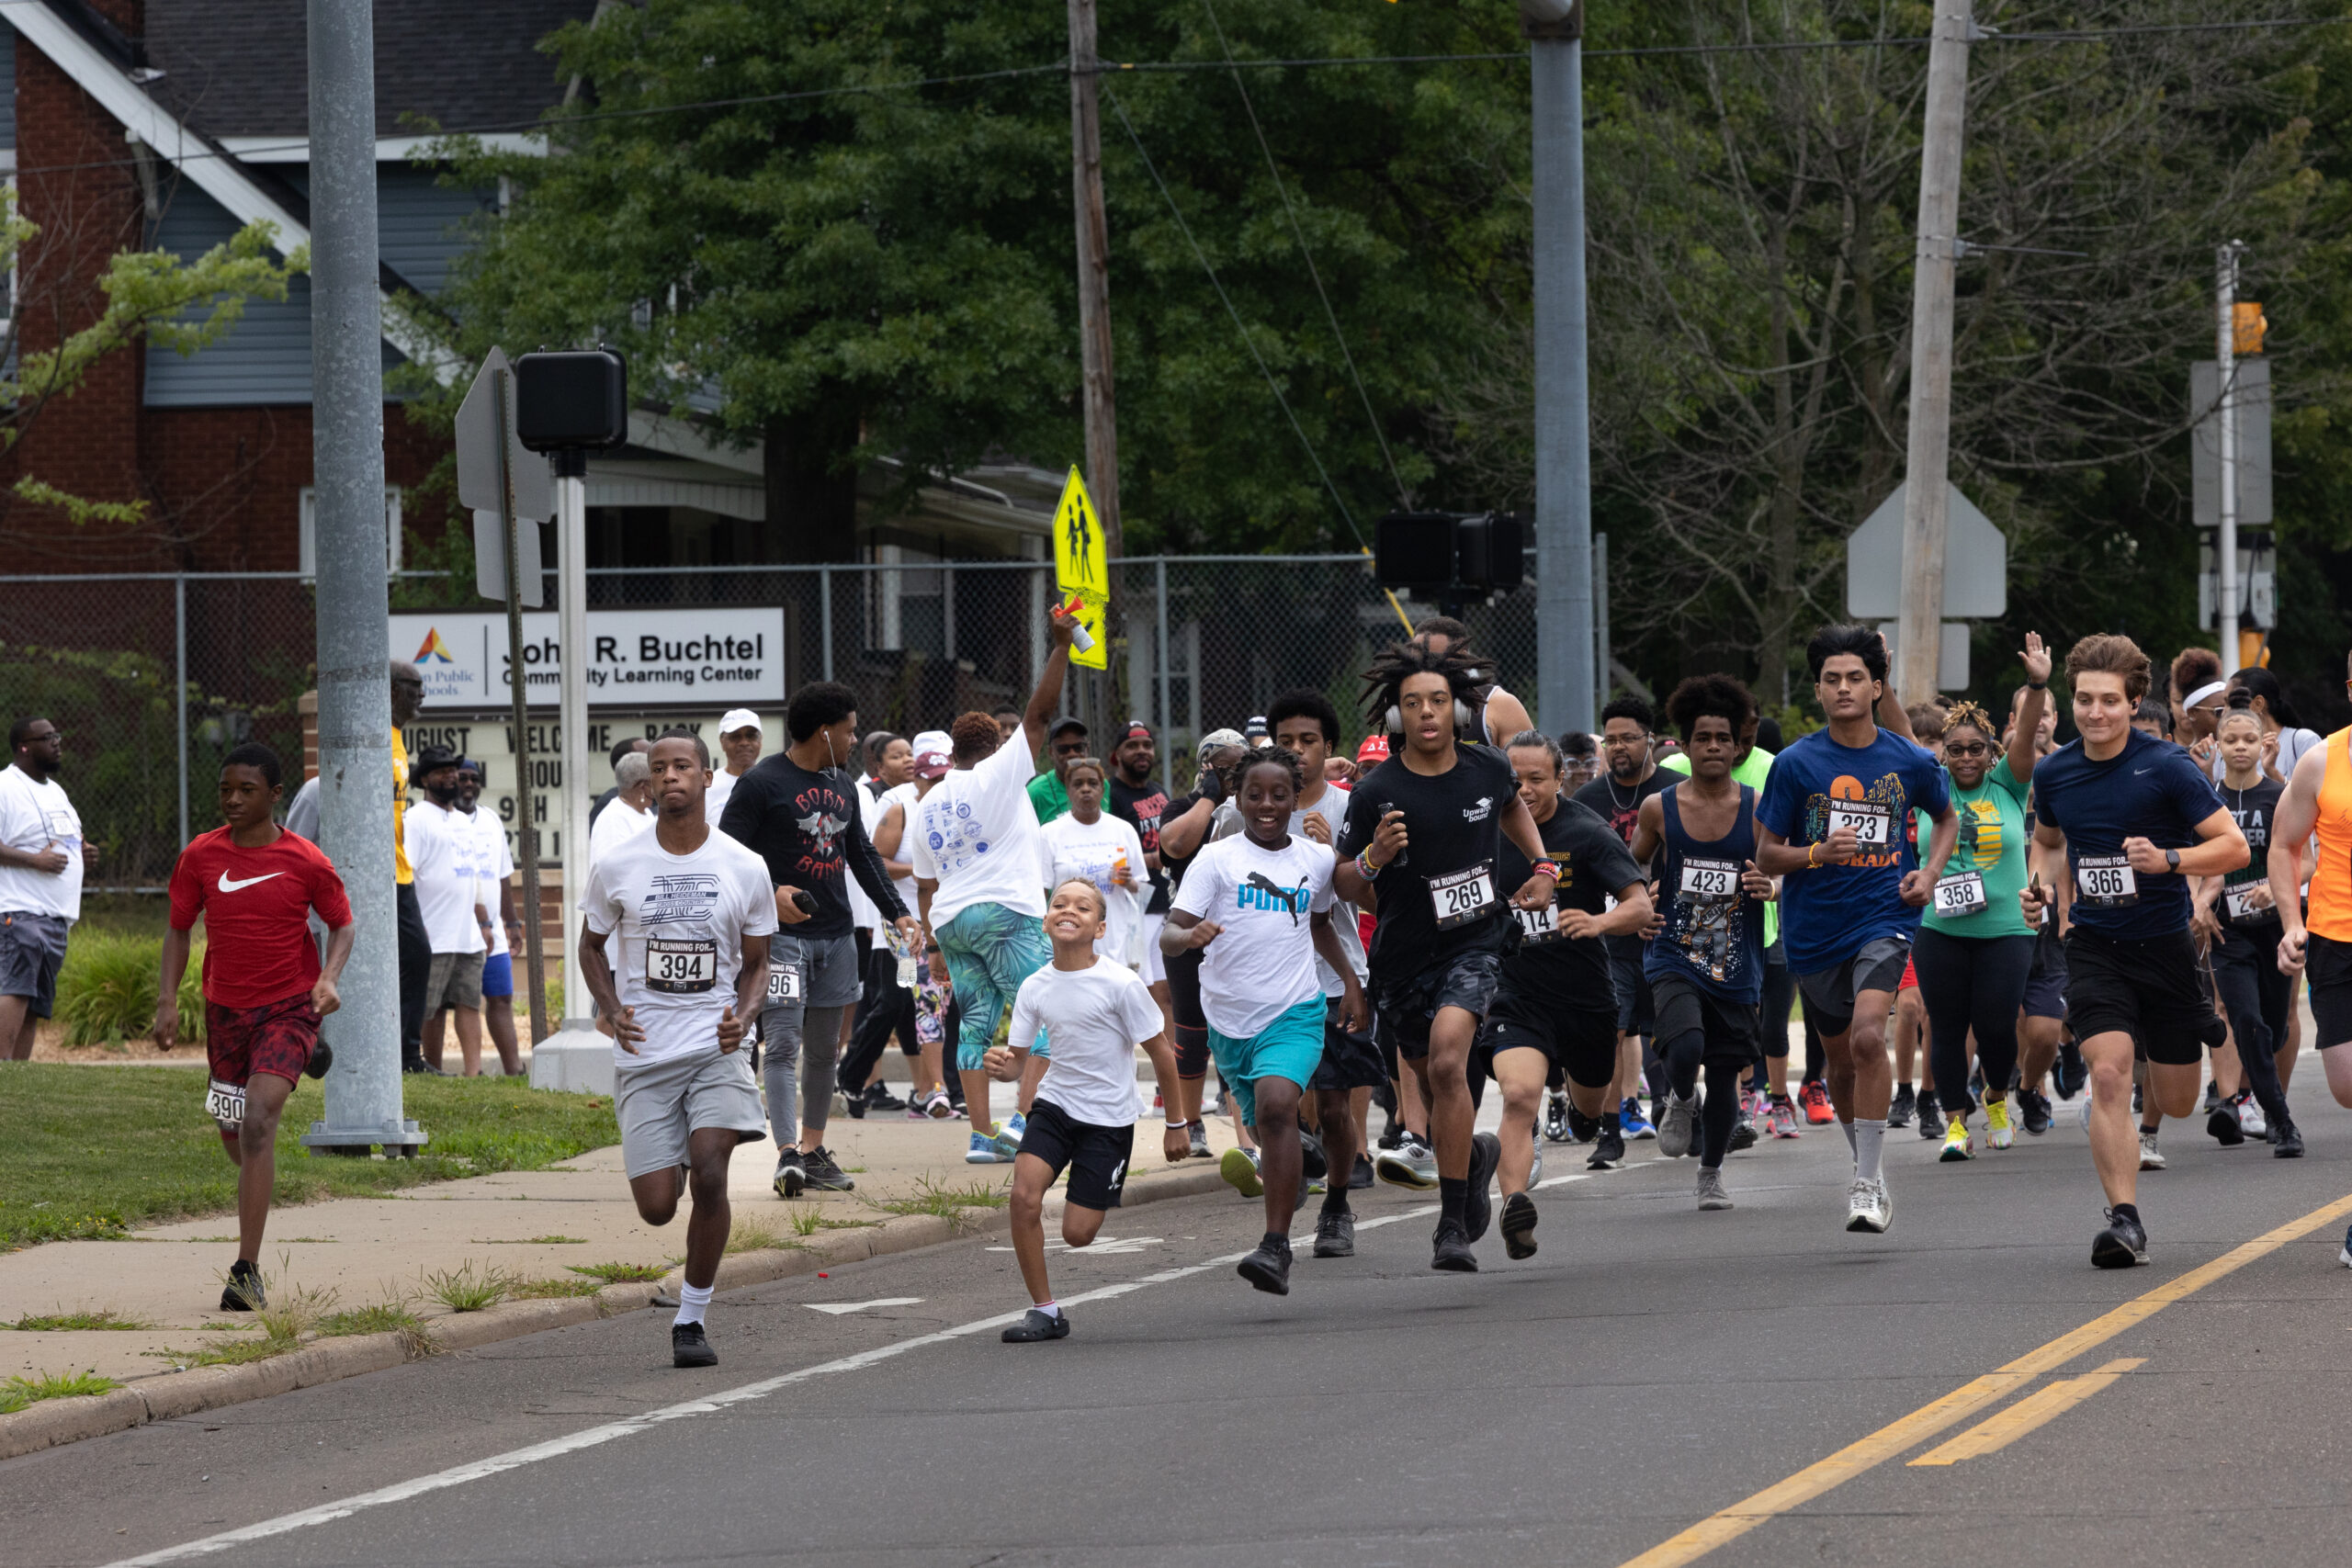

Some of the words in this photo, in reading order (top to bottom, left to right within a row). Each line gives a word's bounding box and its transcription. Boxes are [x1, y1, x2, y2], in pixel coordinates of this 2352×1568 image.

[503, 637, 560, 663] oh
[596, 637, 627, 662] R.
[640, 634, 763, 661] Buchtel
[435, 671, 474, 682] Public
[615, 667, 695, 685] Learning
[701, 665, 763, 682] Center
[424, 683, 458, 695] hools
[401, 727, 470, 754] UGUST
[499, 795, 547, 822] 9H
[1832, 800, 1841, 810] I'M
[1842, 802, 1872, 813] RUNNING
[1872, 806, 1891, 816] FOR...
[1693, 860, 1721, 870] RUNNING
[1721, 863, 1738, 872] FOR...
[2086, 857, 2112, 867] RUNNING
[1430, 878, 1441, 889] I'M
[1441, 871, 1471, 887] RUNNING
[1691, 870, 1726, 894] 423
[1941, 875, 1964, 886] RUNNING
[2087, 870, 2124, 895] 366
[2233, 881, 2258, 895] RUNNING
[656, 893, 671, 901] BILL
[677, 899, 706, 908] COUNTRY
[1238, 884, 1311, 914] PUMA
[1445, 880, 1484, 915] 269
[1943, 884, 1974, 907] 358
[649, 940, 659, 950] I'M
[661, 942, 694, 953] RUNNING
[695, 943, 715, 953] FOR...
[661, 954, 702, 980] 394
[769, 975, 790, 995] 96
[211, 1094, 243, 1121] 390
